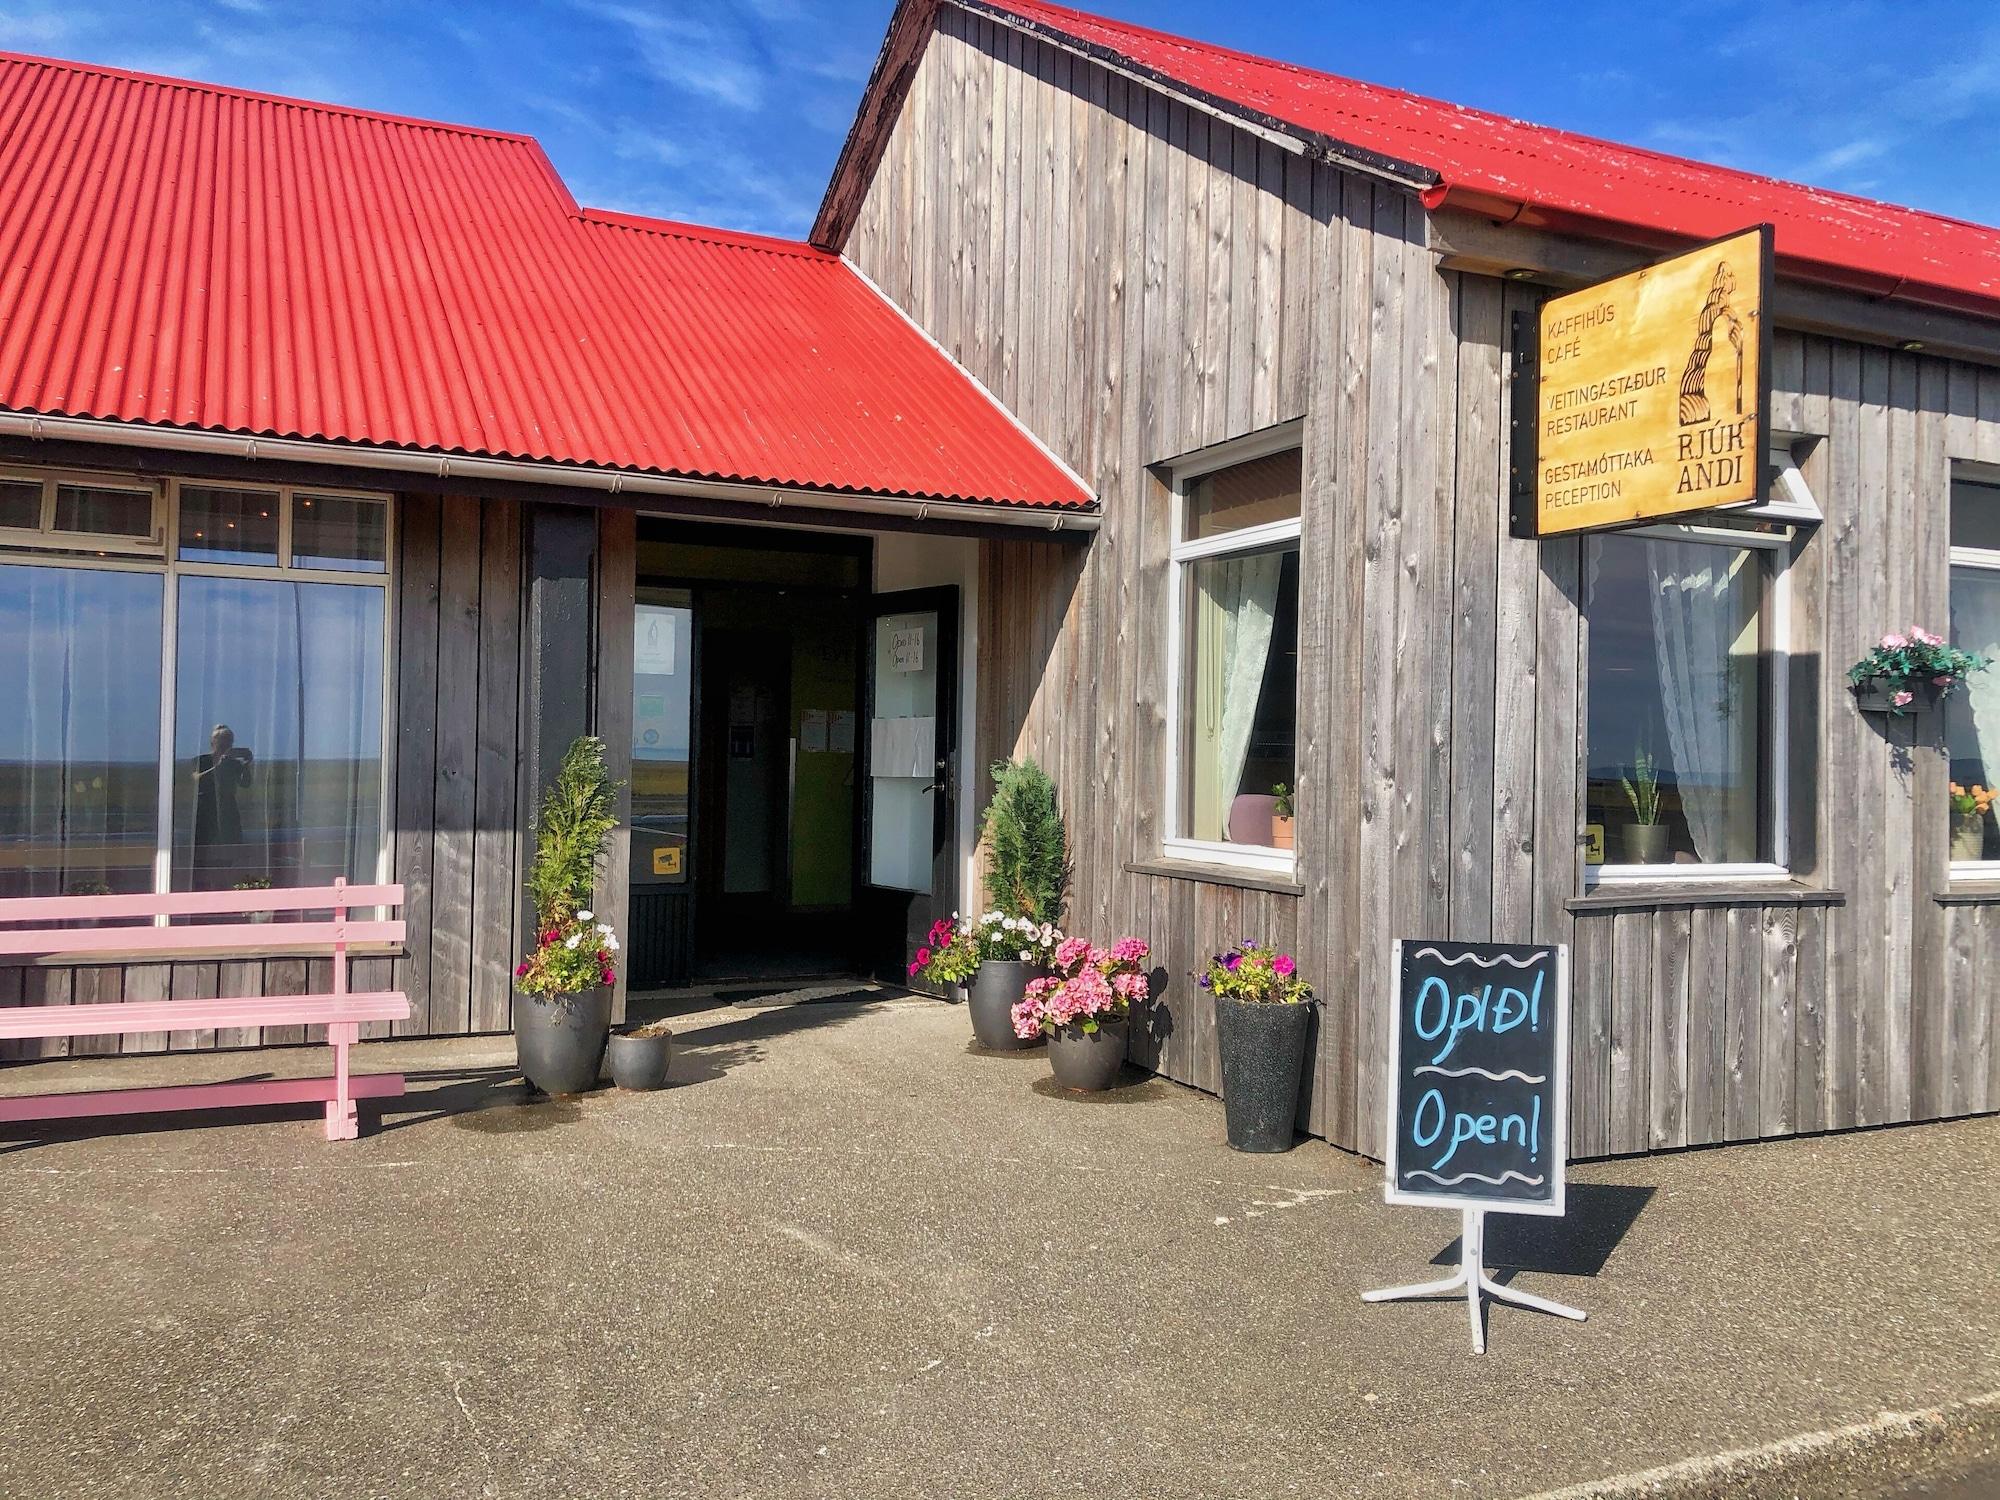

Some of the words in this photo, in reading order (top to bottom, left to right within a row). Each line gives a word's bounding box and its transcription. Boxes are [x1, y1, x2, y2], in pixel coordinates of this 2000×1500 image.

[1547, 303, 1615, 340] KAFFIHÚS
[1547, 336, 1581, 365] CAFÉ
[1547, 367, 1666, 411] VEITINGASTAÐUR
[1547, 400, 1638, 437] RESTAURANT
[1677, 419, 1745, 462] RJÚK
[1545, 448, 1654, 485] GESTAMÓTTAKA
[1677, 454, 1743, 494] ANDI
[1545, 480, 1621, 510] RECEPTION
[1413, 1089, 1540, 1170] Open!
